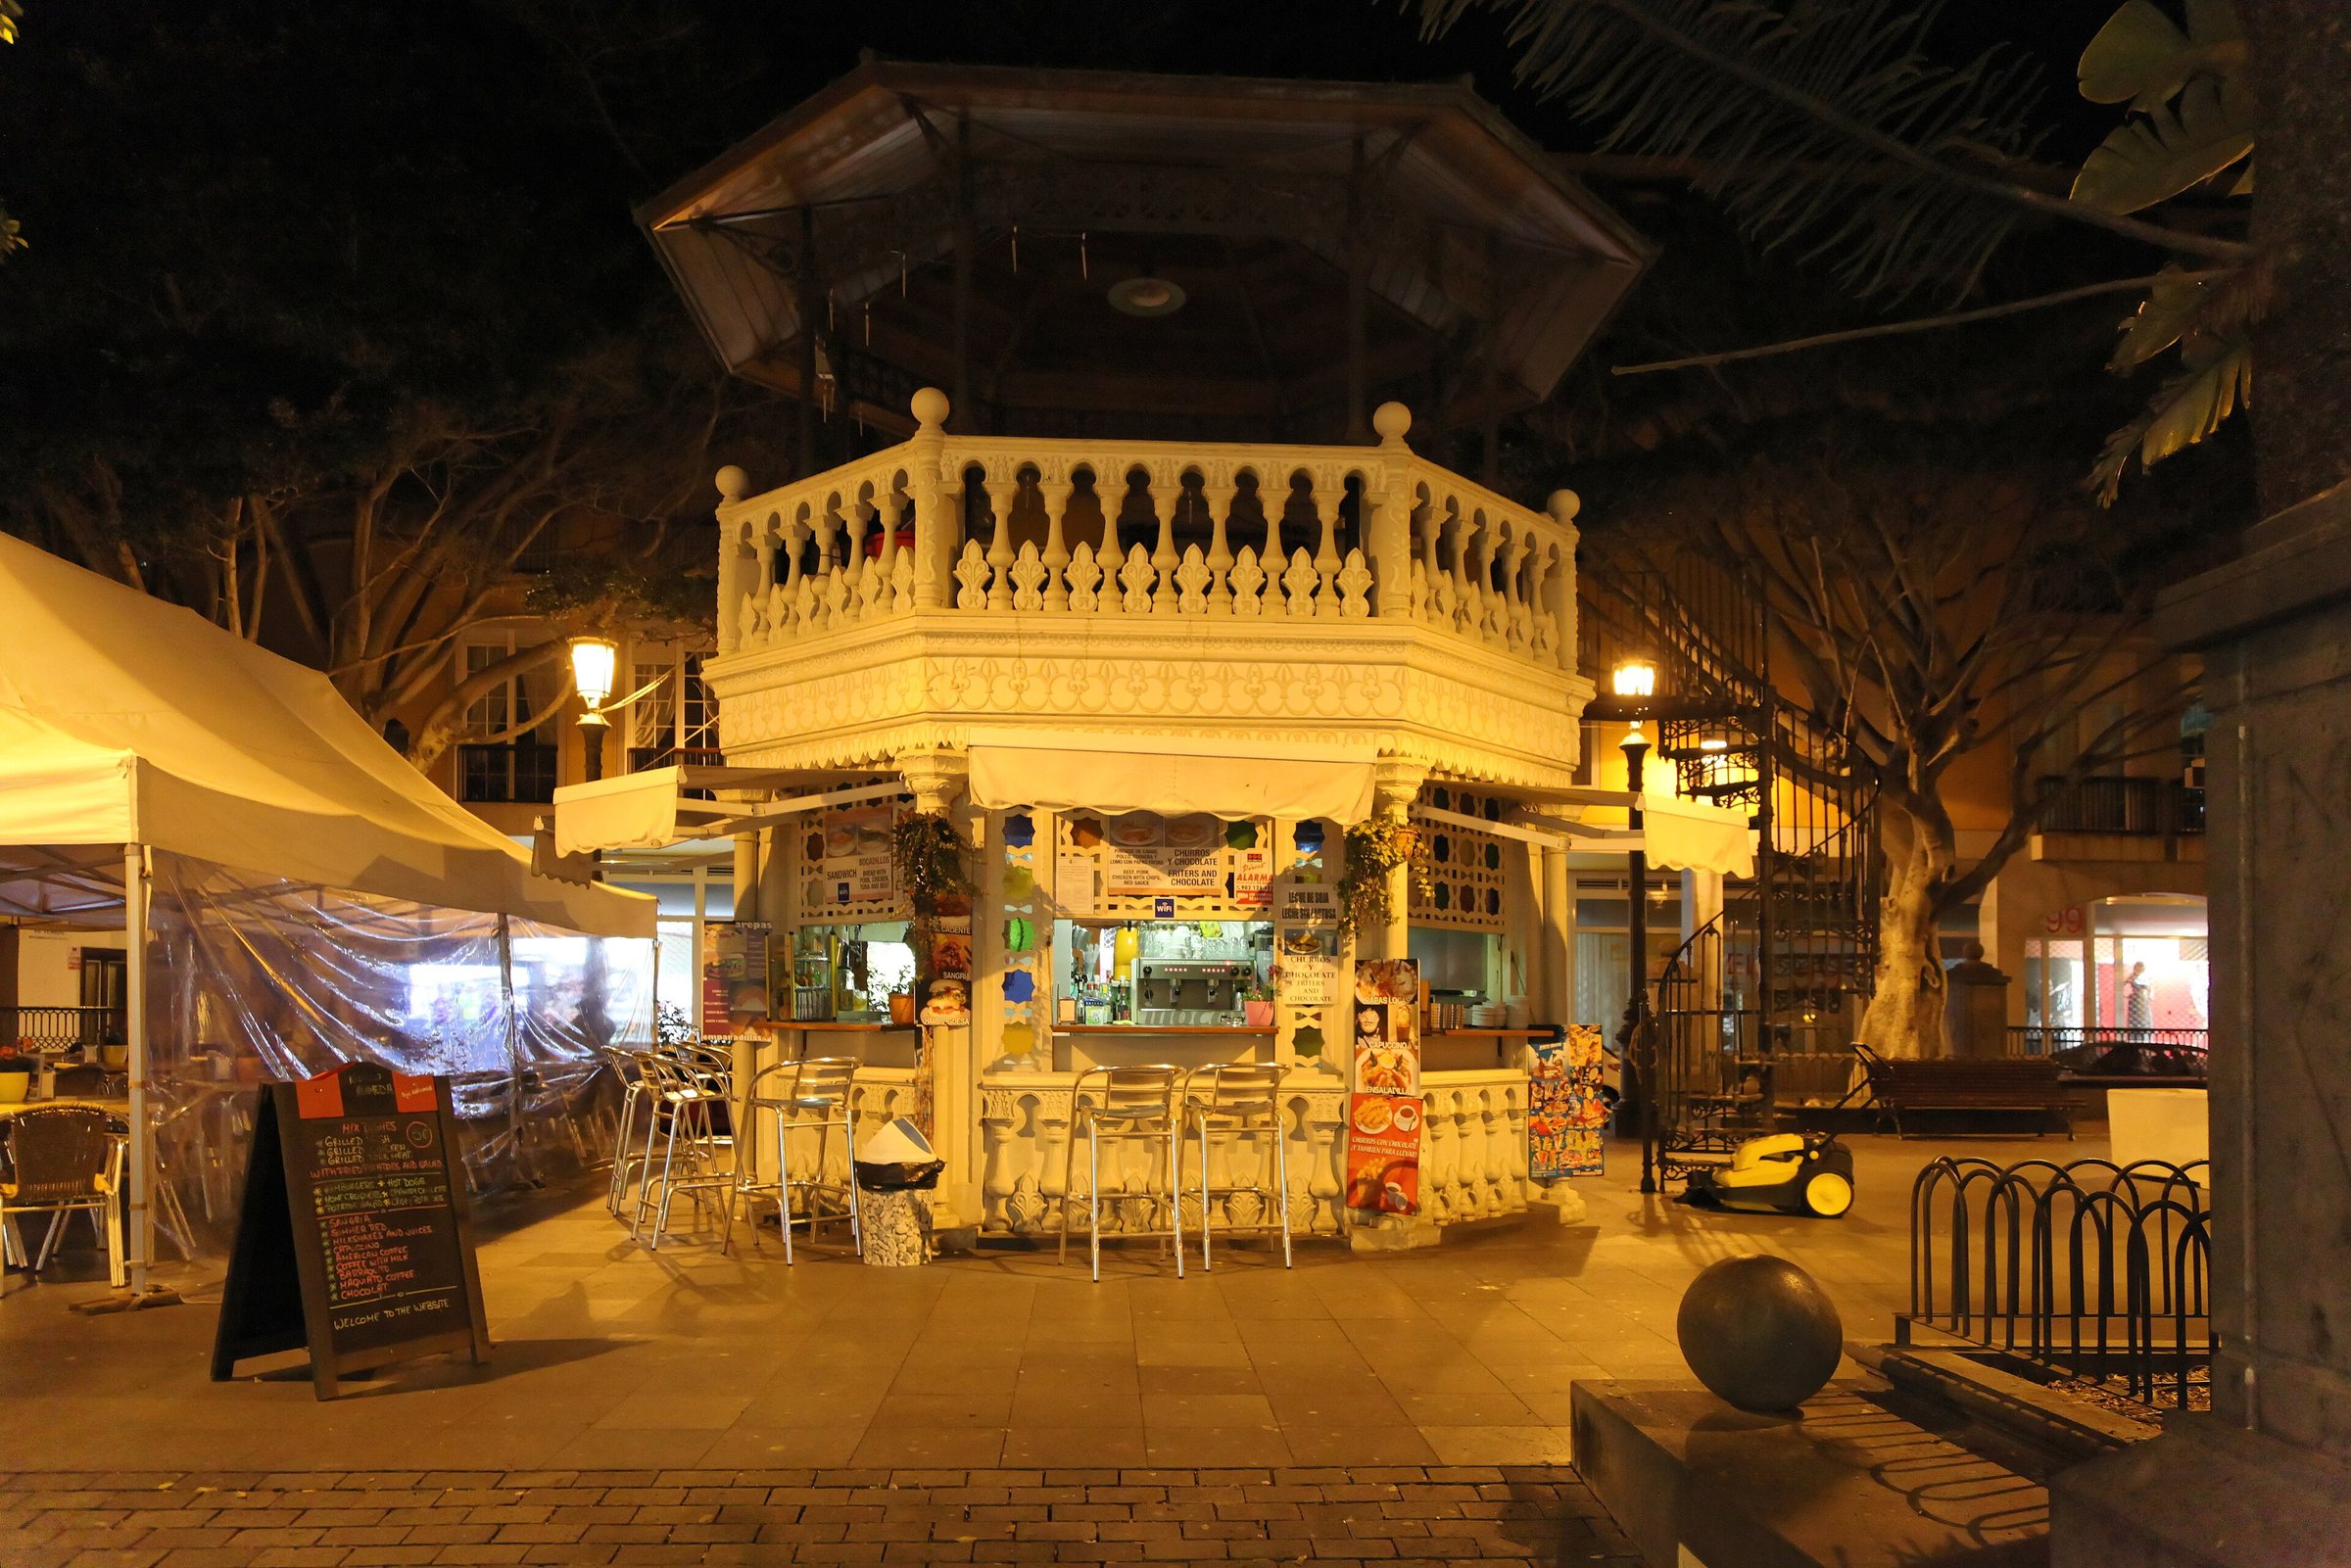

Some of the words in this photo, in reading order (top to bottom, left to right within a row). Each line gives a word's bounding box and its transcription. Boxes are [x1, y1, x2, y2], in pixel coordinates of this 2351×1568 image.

[859, 856, 889, 866] BOCADILLOS
[827, 869, 857, 880] SANDWICH
[1288, 892, 1306, 903] LECHE
[1307, 892, 1315, 903] DE
[1316, 892, 1329, 903] SOJA
[1281, 908, 1301, 919] LECHE
[1301, 908, 1311, 919] SIN
[1311, 908, 1336, 920] LACTOSA
[1366, 1086, 1412, 1095] ENSALADILLA
[342, 1122, 360, 1135] MIX
[324, 1136, 363, 1148] GRILLED
[1352, 1136, 1376, 1145] CHURROS
[326, 1146, 364, 1157] GRILLED
[1381, 1147, 1396, 1156] PARA
[327, 1155, 365, 1165] GRILLED
[403, 1160, 417, 1169] AND
[418, 1159, 442, 1168] SALAD
[387, 1177, 401, 1188] HOT
[403, 1176, 426, 1188] DOGS
[329, 1214, 371, 1227] SANGRIA
[331, 1225, 366, 1238] SUMMER
[369, 1222, 388, 1233] RED
[333, 1231, 383, 1245] MILKSHAKES
[386, 1228, 404, 1239] AND
[405, 1224, 433, 1236] JUICES
[336, 1249, 378, 1262] AMERICAN
[379, 1245, 408, 1257] COFFEE
[336, 1259, 367, 1272] COFFEE
[368, 1256, 389, 1266] WITH
[390, 1254, 408, 1262] MILK
[385, 1269, 415, 1282] COFFEE
[333, 1311, 380, 1331] WELCOME
[383, 1309, 395, 1319] TO
[395, 1305, 411, 1315] THE
[413, 1298, 450, 1314] WEBSITE
